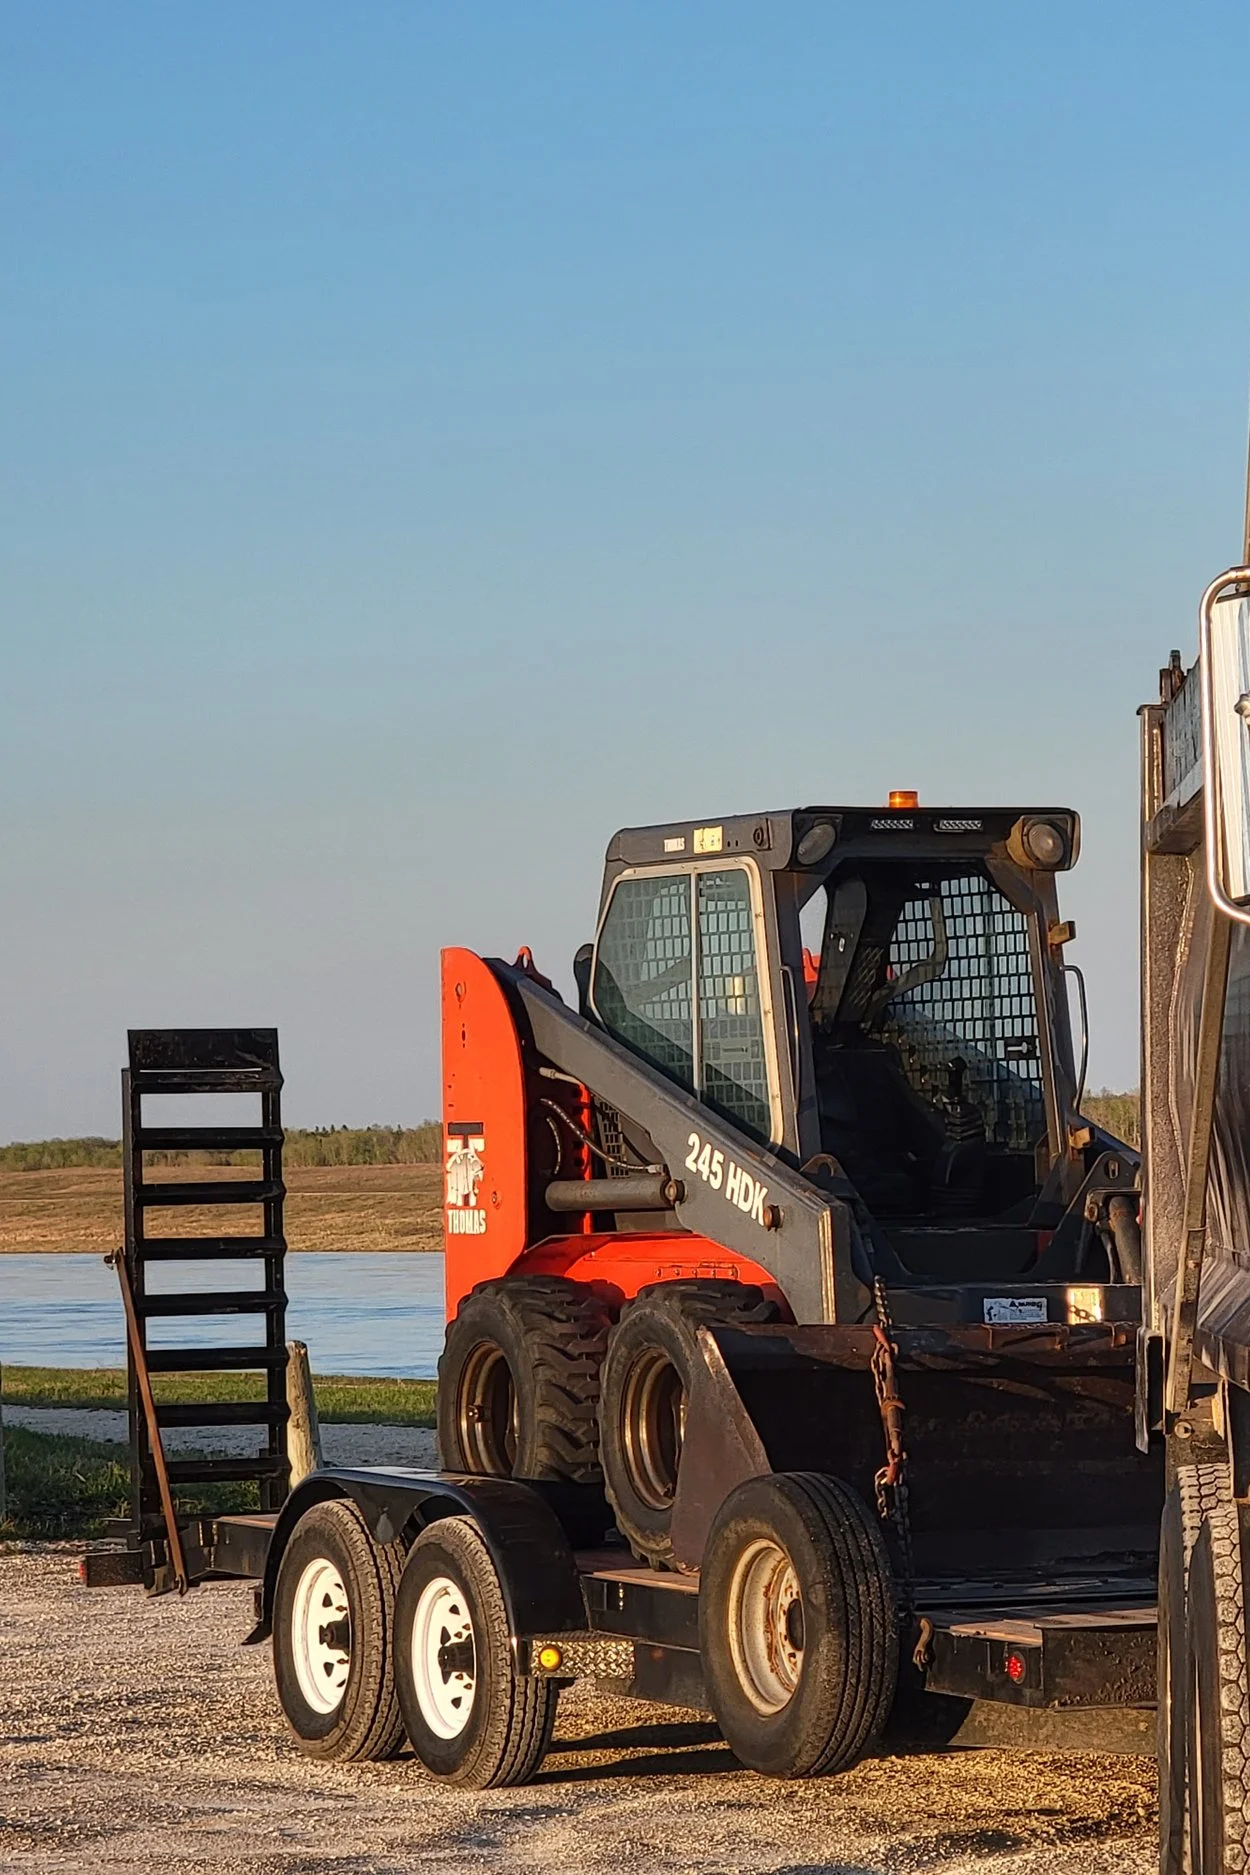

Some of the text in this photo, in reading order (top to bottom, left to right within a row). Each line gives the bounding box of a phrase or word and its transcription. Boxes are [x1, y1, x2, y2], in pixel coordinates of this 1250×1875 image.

[685, 1132, 768, 1227] 245 HDK
[447, 1209, 487, 1234] THOMAS
